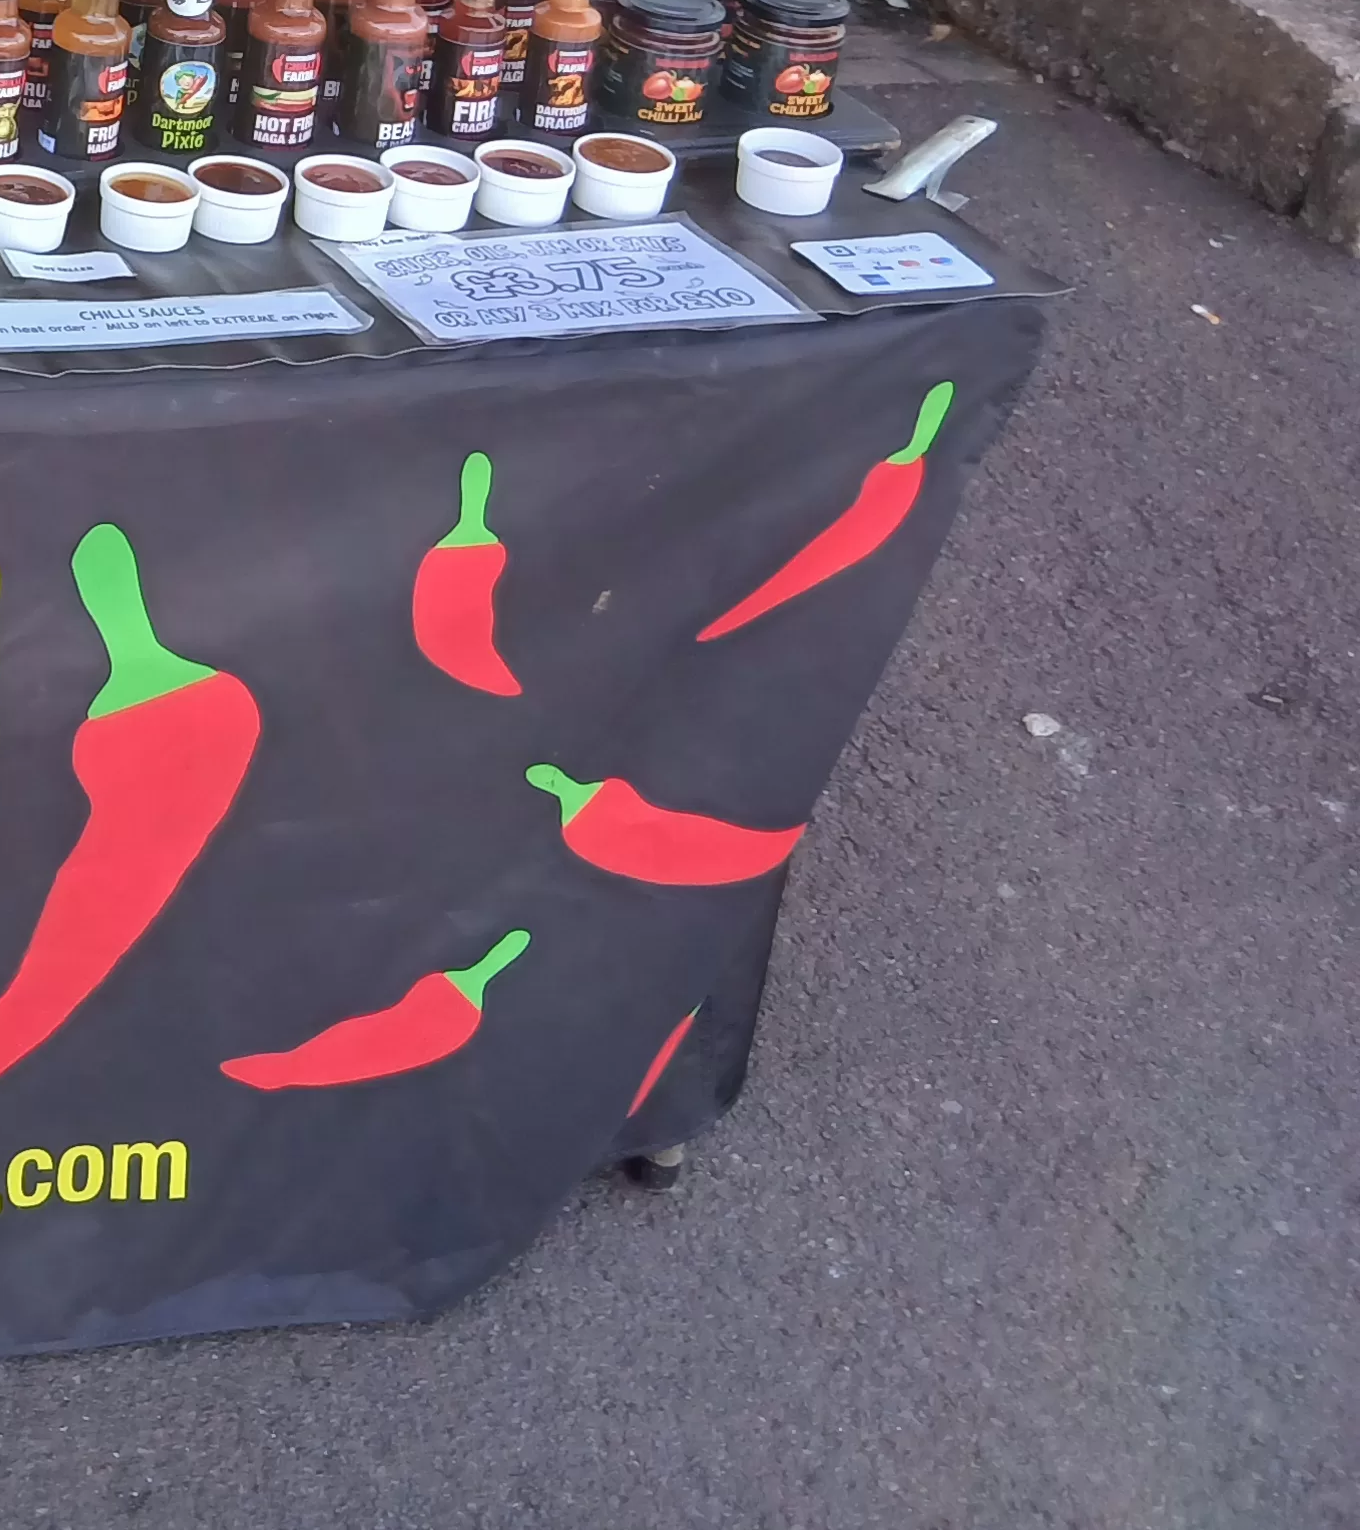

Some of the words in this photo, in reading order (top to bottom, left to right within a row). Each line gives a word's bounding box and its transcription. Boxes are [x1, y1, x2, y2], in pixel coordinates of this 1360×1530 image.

[655, 102, 695, 112] SWEET
[787, 95, 824, 105] SWEET
[638, 109, 679, 122] CHILLI
[770, 103, 809, 115] CHILLI
[255, 115, 288, 131] HOT
[253, 131, 286, 144] NAGA
[288, 132, 297, 143] &
[375, 250, 470, 278] SAUCES,
[465, 243, 528, 262] OILS,
[525, 239, 576, 256] JAM
[577, 238, 609, 252] OR
[618, 236, 687, 253] SALTS
[855, 245, 922, 255] Square
[450, 257, 665, 301] £3.75
[79, 309, 134, 321] CHILLI
[138, 306, 204, 317] SAUCES
[434, 311, 470, 328] OR
[477, 306, 528, 324] ANY
[532, 303, 559, 321] 3
[561, 301, 616, 320] MIX
[619, 296, 679, 314] FOR
[670, 287, 755, 311] £10
[12, 325, 44, 333] heat
[49, 324, 86, 332] order
[105, 321, 139, 331] MILD
[164, 319, 191, 328] left
[212, 315, 278, 324] EXTREME
[303, 312, 336, 321] right
